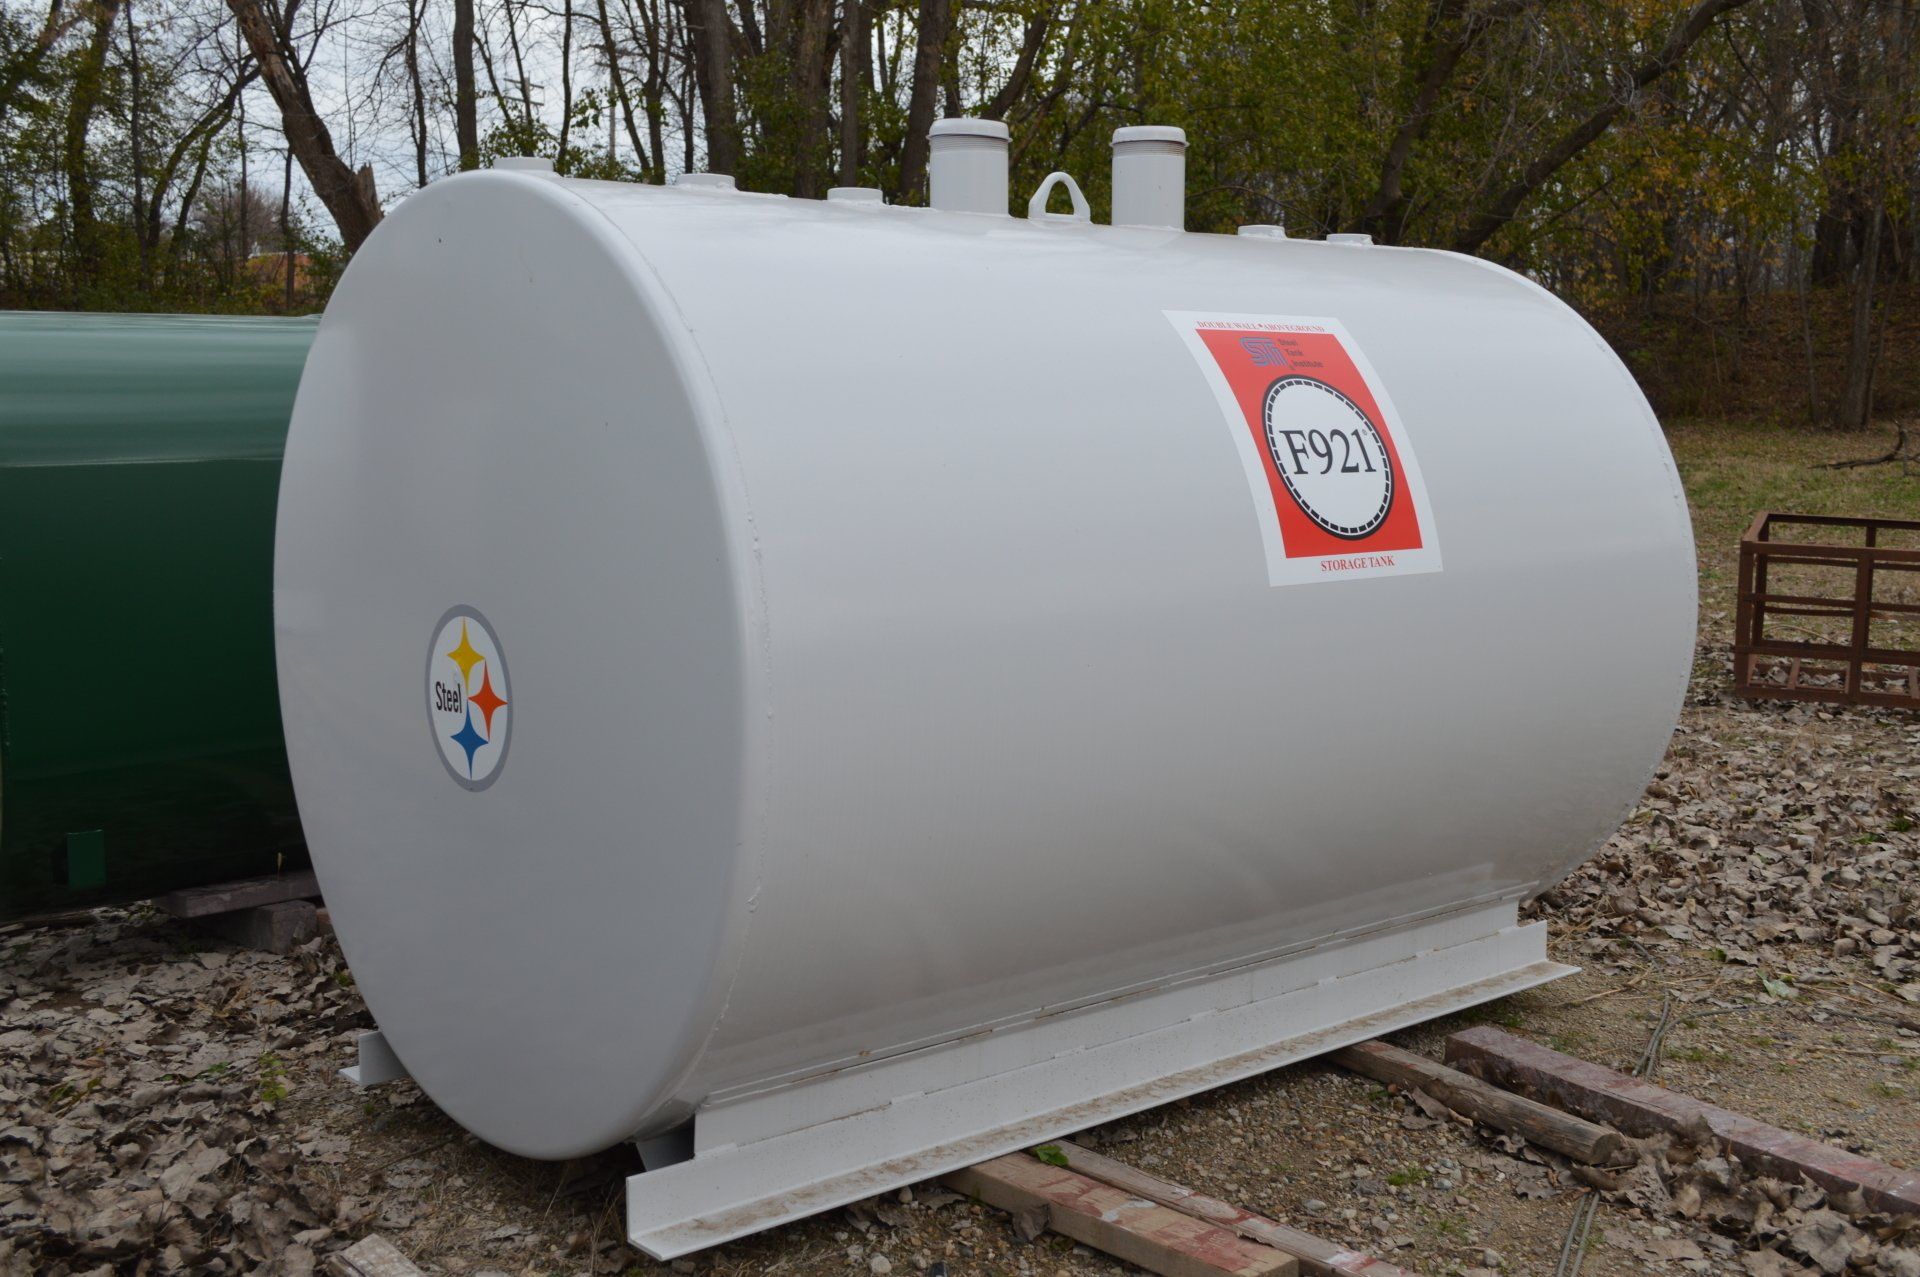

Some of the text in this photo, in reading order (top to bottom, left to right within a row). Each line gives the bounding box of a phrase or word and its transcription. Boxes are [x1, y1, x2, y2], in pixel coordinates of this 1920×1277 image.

[1320, 555, 1395, 572] STORAGE TANK
[435, 681, 463, 713] Steel
